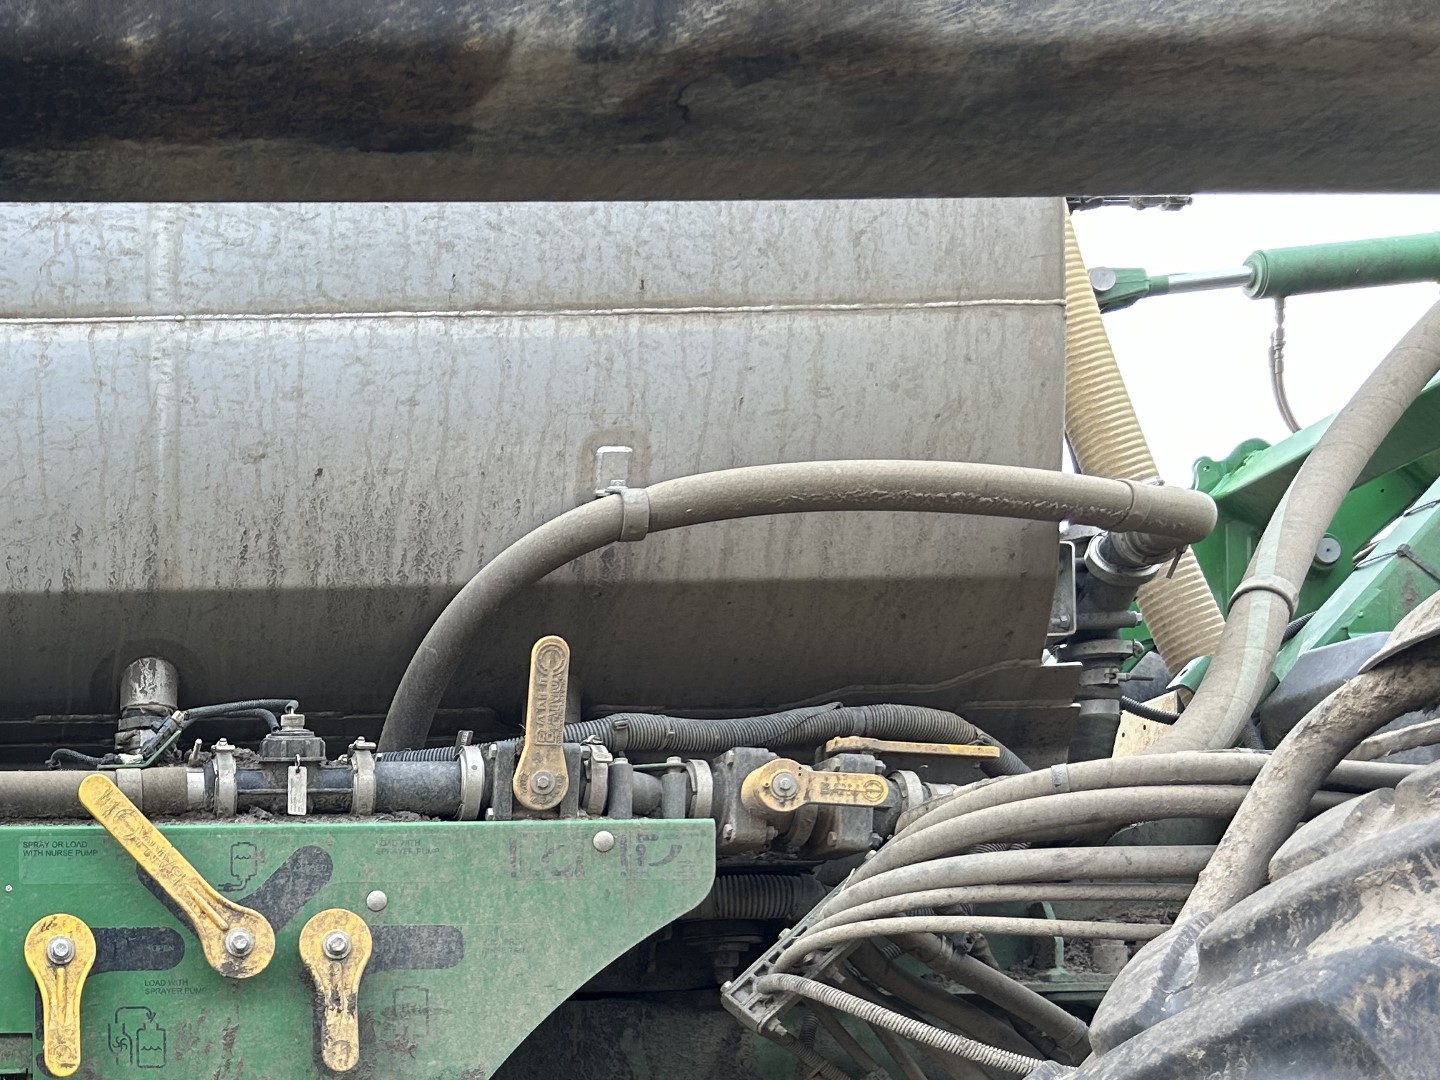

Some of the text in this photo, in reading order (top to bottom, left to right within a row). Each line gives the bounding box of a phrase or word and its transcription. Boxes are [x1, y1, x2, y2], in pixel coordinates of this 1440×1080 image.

[22, 840, 88, 849] SPRAY OR LOAD
[22, 849, 99, 857] WITH NURSE PUMP
[150, 944, 176, 953] OPEN
[144, 978, 189, 988] LOAD WITH
[144, 987, 184, 996] SPRAYER
